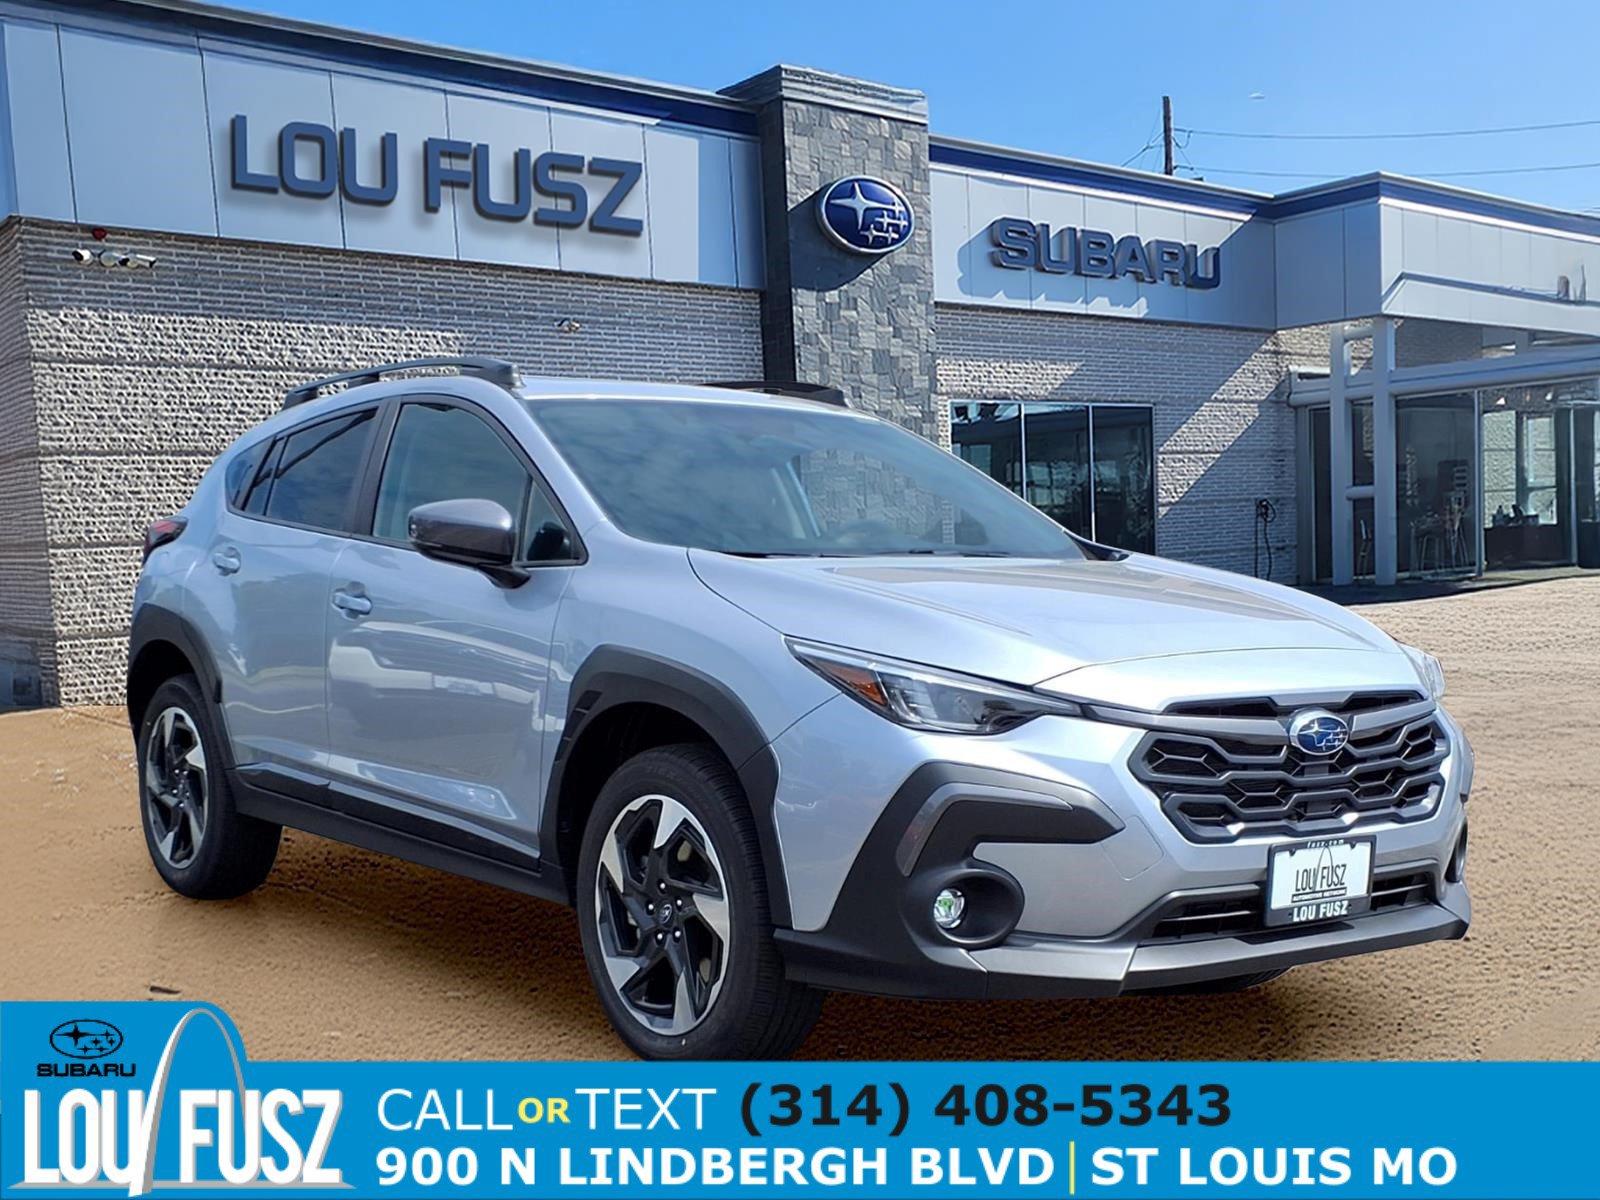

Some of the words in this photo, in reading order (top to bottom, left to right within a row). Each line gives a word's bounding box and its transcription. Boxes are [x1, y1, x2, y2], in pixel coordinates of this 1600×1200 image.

[230, 114, 398, 207] LOU
[423, 137, 644, 236] FUSZ
[991, 216, 1221, 290] SUBARU
[1295, 867, 1316, 892] LOU
[1320, 864, 1347, 888] FUSZ
[1292, 903, 1316, 922] LOU
[1319, 900, 1349, 918] FUSZ
